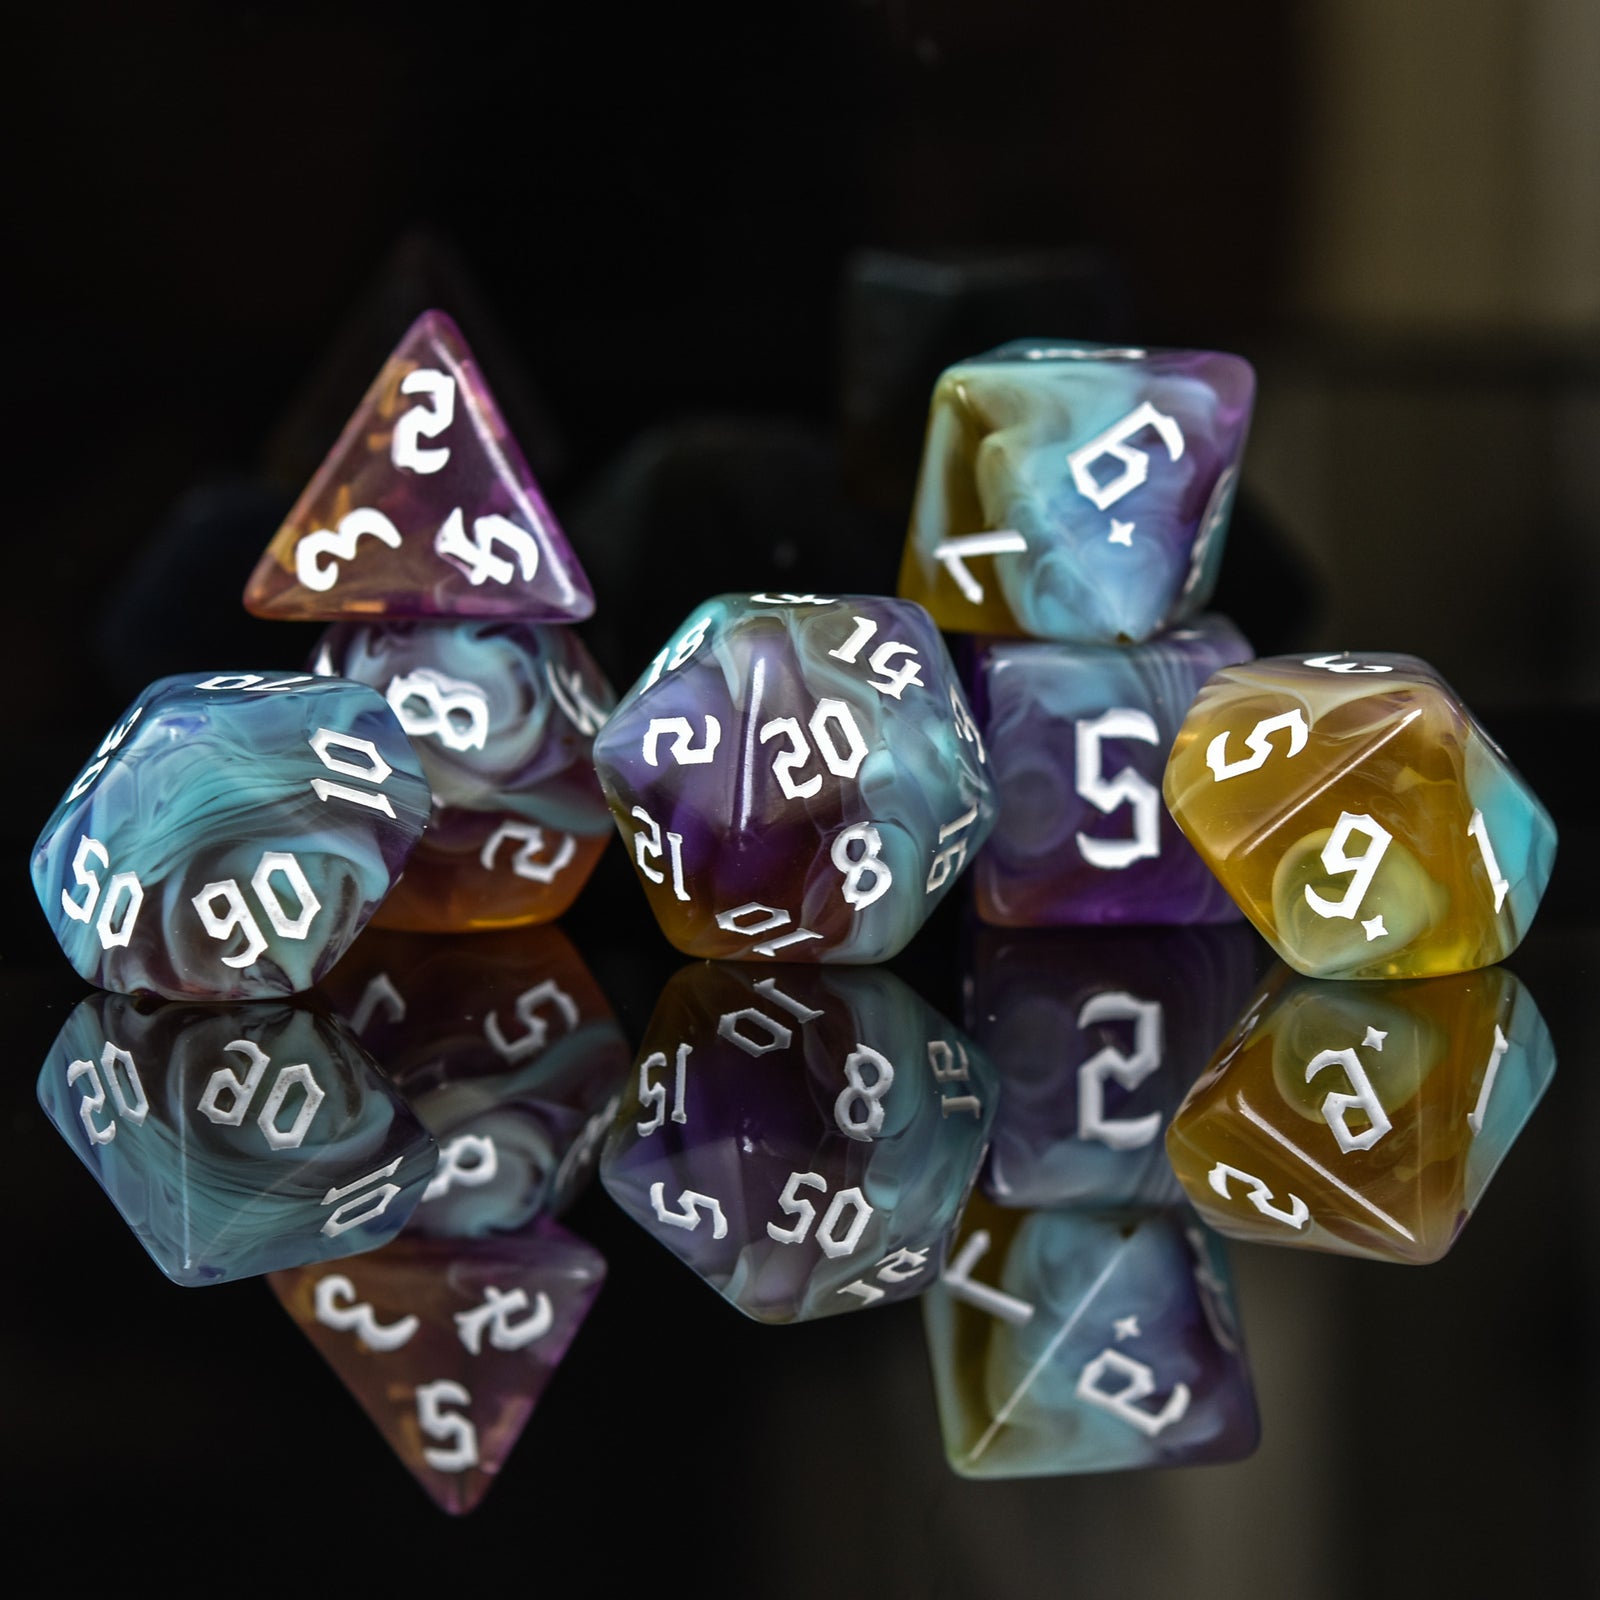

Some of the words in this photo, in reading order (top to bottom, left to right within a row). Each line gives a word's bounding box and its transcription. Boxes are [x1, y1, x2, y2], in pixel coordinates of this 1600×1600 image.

[392, 369, 455, 474] 2
[296, 507, 401, 591] 3
[828, 616, 926, 700] 14
[386, 668, 489, 752] 8
[760, 698, 869, 799] 20
[309, 728, 396, 818] 10
[1075, 707, 1160, 869] 5
[62, 834, 145, 949] 50
[191, 851, 321, 968] 90
[830, 822, 892, 911] 8
[1467, 808, 1509, 914] 1
